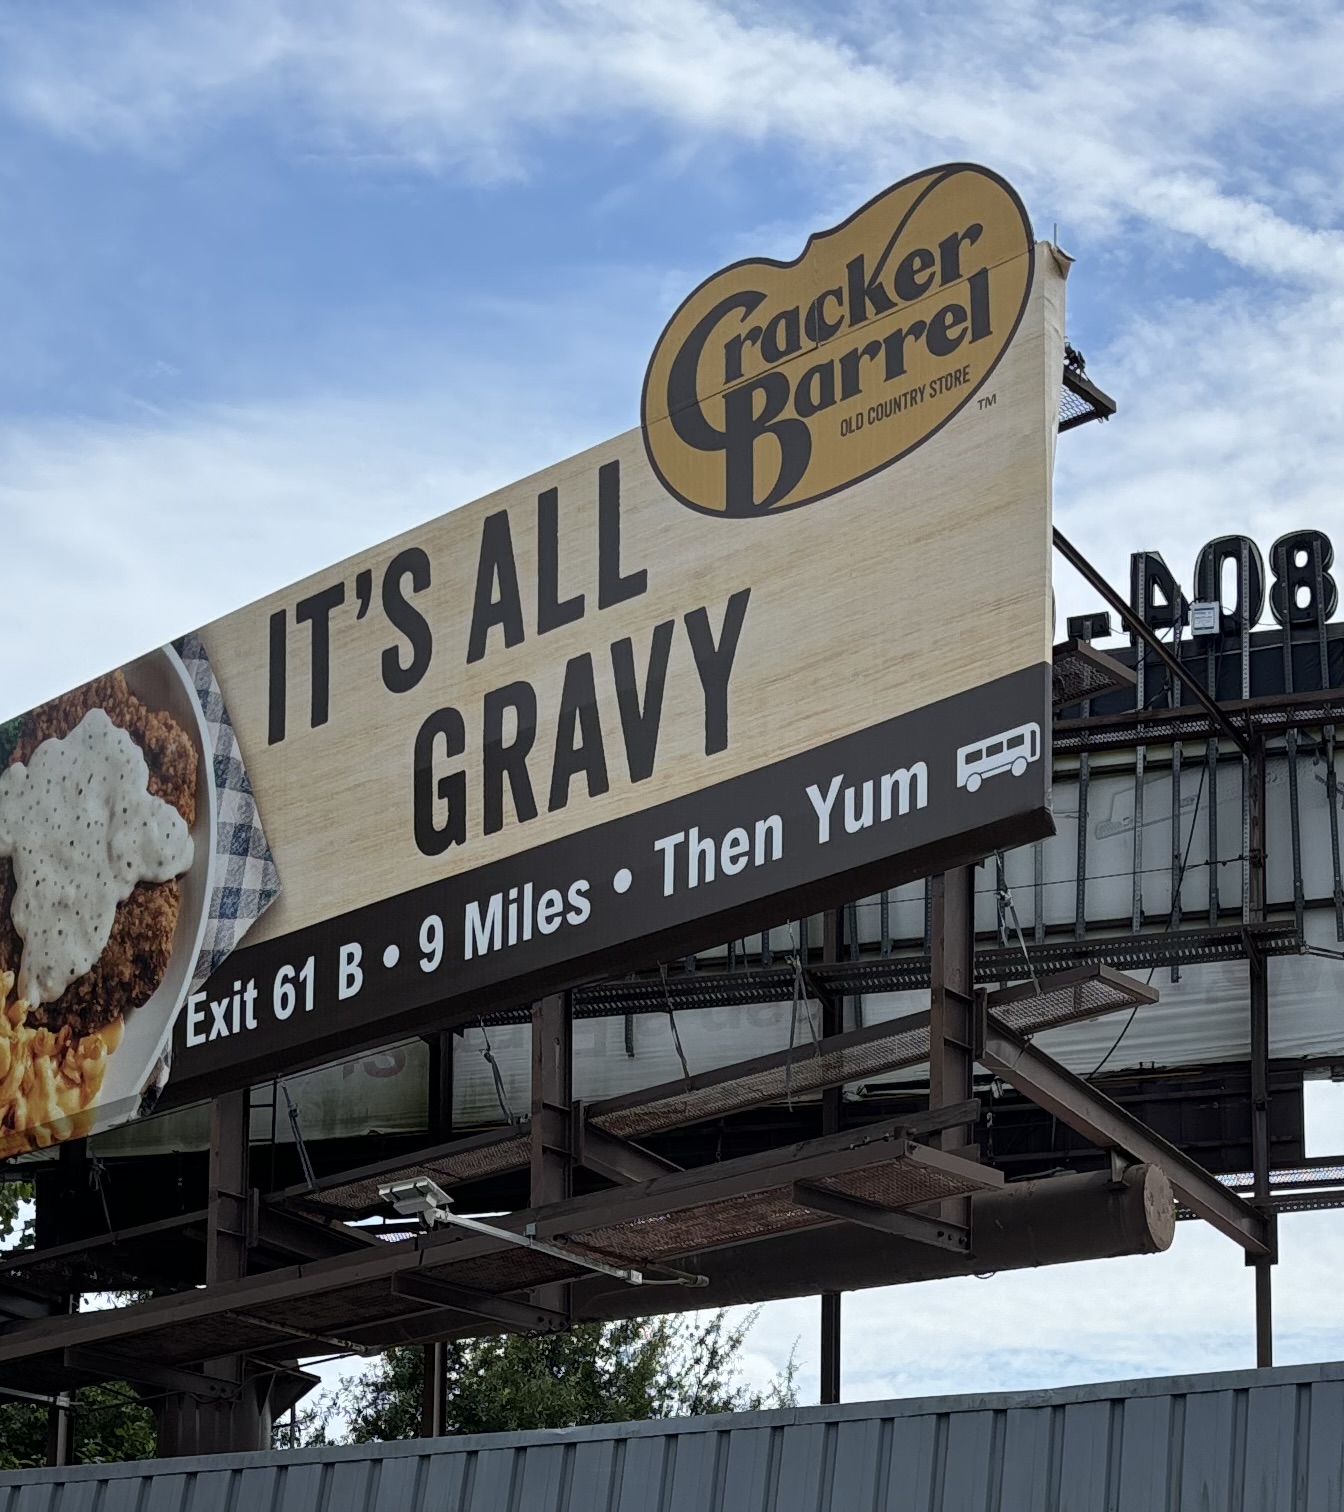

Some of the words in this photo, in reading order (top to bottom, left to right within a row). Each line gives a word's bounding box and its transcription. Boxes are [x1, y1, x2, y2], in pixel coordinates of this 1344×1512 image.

[668, 223, 983, 451] Cracker
[722, 267, 993, 512] Barrel
[840, 411, 864, 437] OLD
[867, 383, 926, 425] COUNTRY
[929, 364, 971, 400] STORE
[268, 547, 433, 745] IT'S
[466, 460, 647, 664] ALL
[414, 587, 751, 856] GRAVY
[186, 978, 258, 1048] Exit
[273, 956, 315, 1021] 61
[338, 942, 364, 1001] B
[418, 915, 445, 974] 9
[464, 879, 592, 961] Miles
[654, 814, 783, 897] Then
[806, 761, 928, 844] Yum
